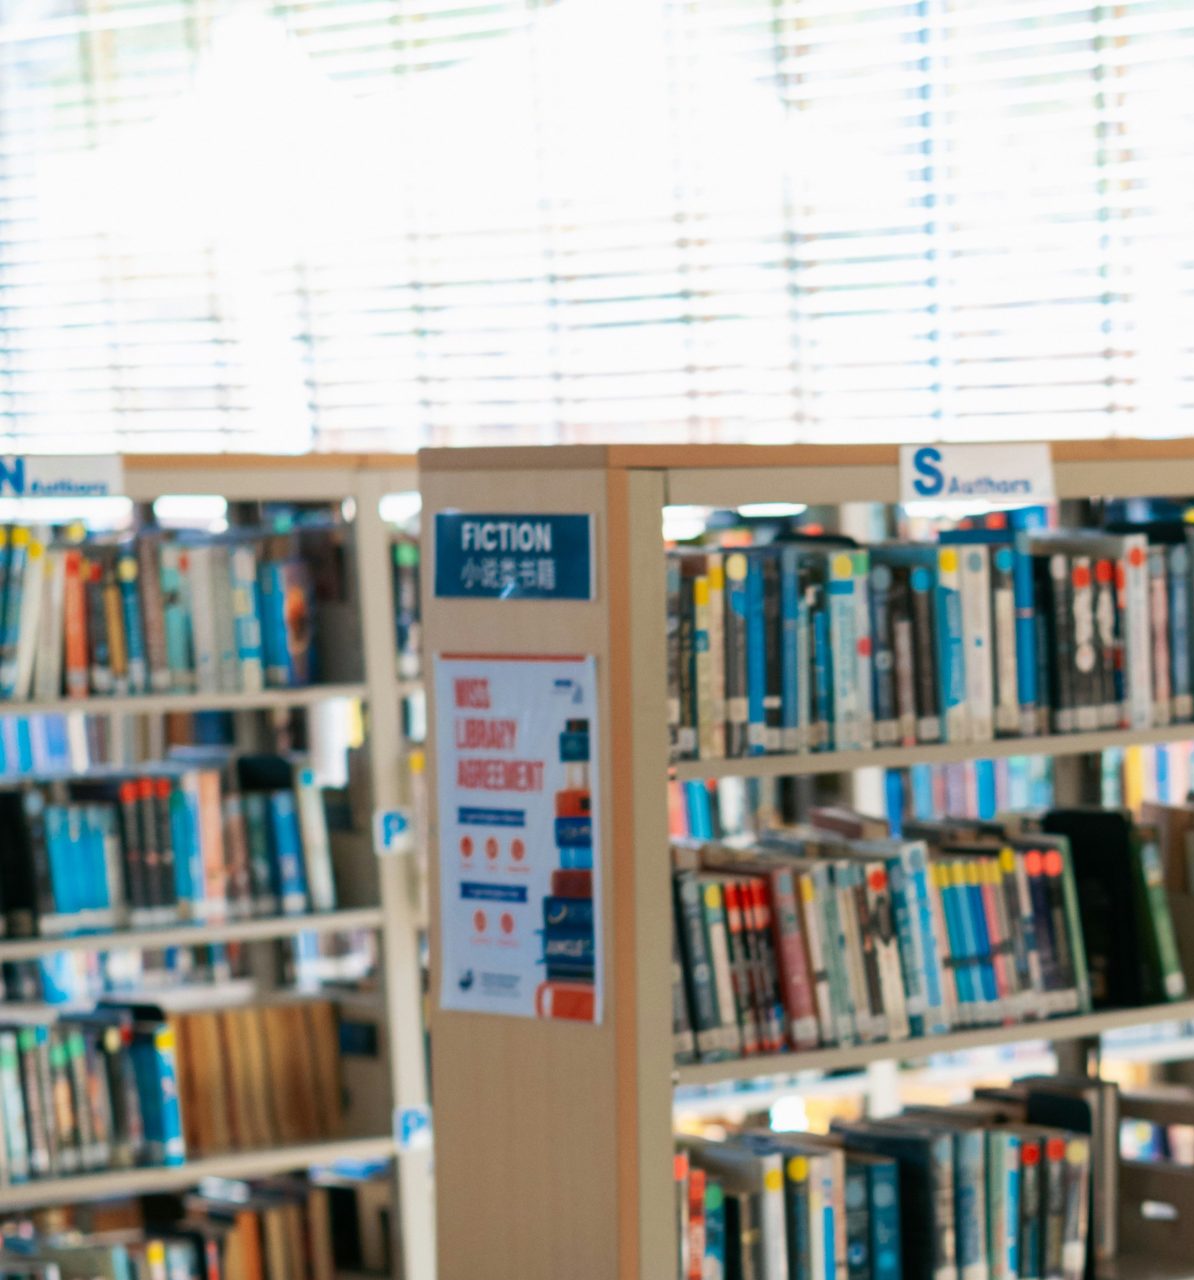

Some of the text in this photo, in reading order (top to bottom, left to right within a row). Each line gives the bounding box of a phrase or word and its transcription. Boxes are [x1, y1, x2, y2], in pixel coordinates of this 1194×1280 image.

[913, 447, 1031, 496] S Authors
[461, 522, 552, 552] FICTION
[461, 558, 556, 590] 小说类书籍
[455, 717, 518, 751] LIBRARY
[457, 757, 545, 792] AGREEMENT
[382, 810, 409, 848] P
[400, 1108, 427, 1147] P
